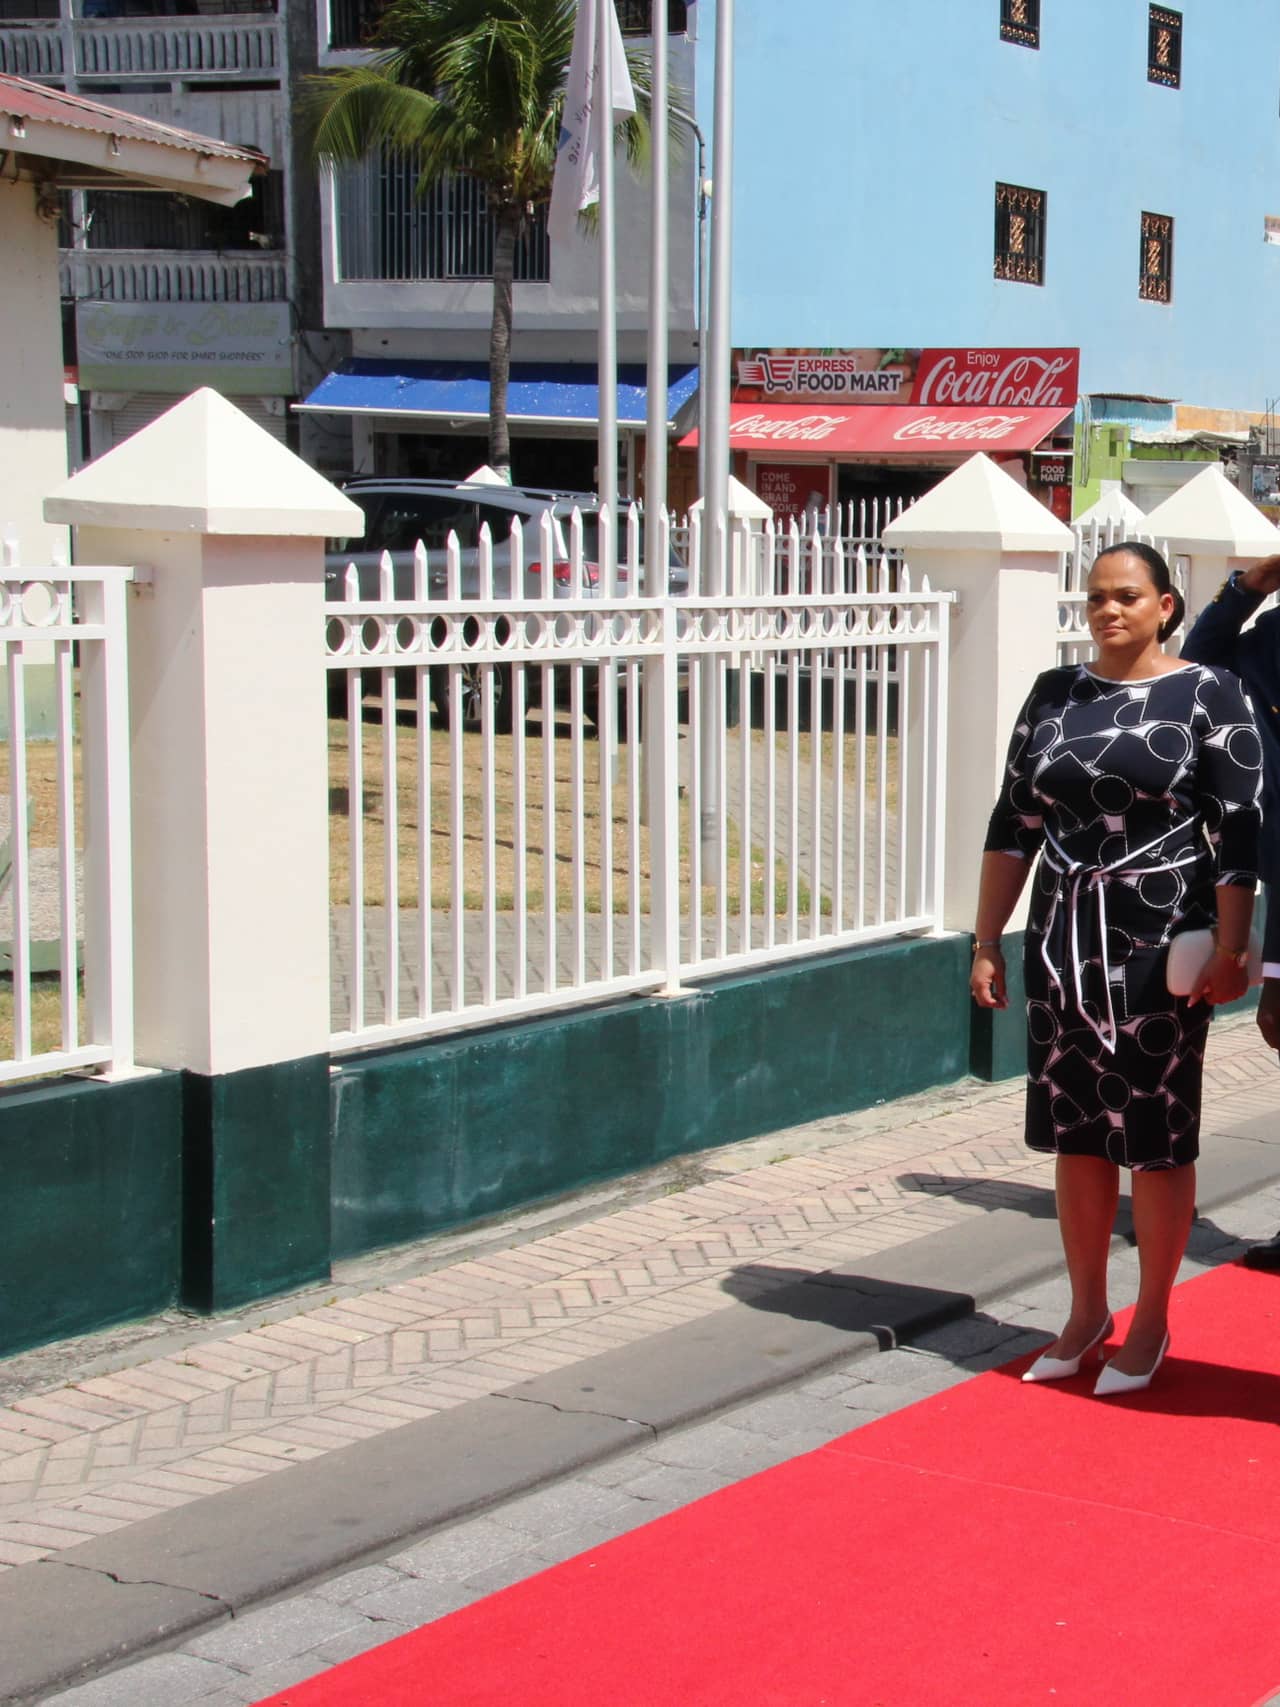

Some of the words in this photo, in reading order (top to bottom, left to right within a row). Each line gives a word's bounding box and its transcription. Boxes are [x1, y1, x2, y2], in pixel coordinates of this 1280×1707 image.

[967, 351, 1000, 367] Enjoy
[798, 360, 855, 372] EXPRESS
[797, 374, 846, 391] FOOD
[851, 374, 900, 392] MART
[920, 356, 1073, 405] Coca-Cola
[1040, 465, 1065, 473] FOOD
[761, 472, 790, 482] COME
[1040, 474, 1065, 483] MART
[761, 482, 772, 491] IN
[774, 483, 796, 492] AND
[761, 492, 789, 502] GRAB
[773, 503, 799, 512] COKE
